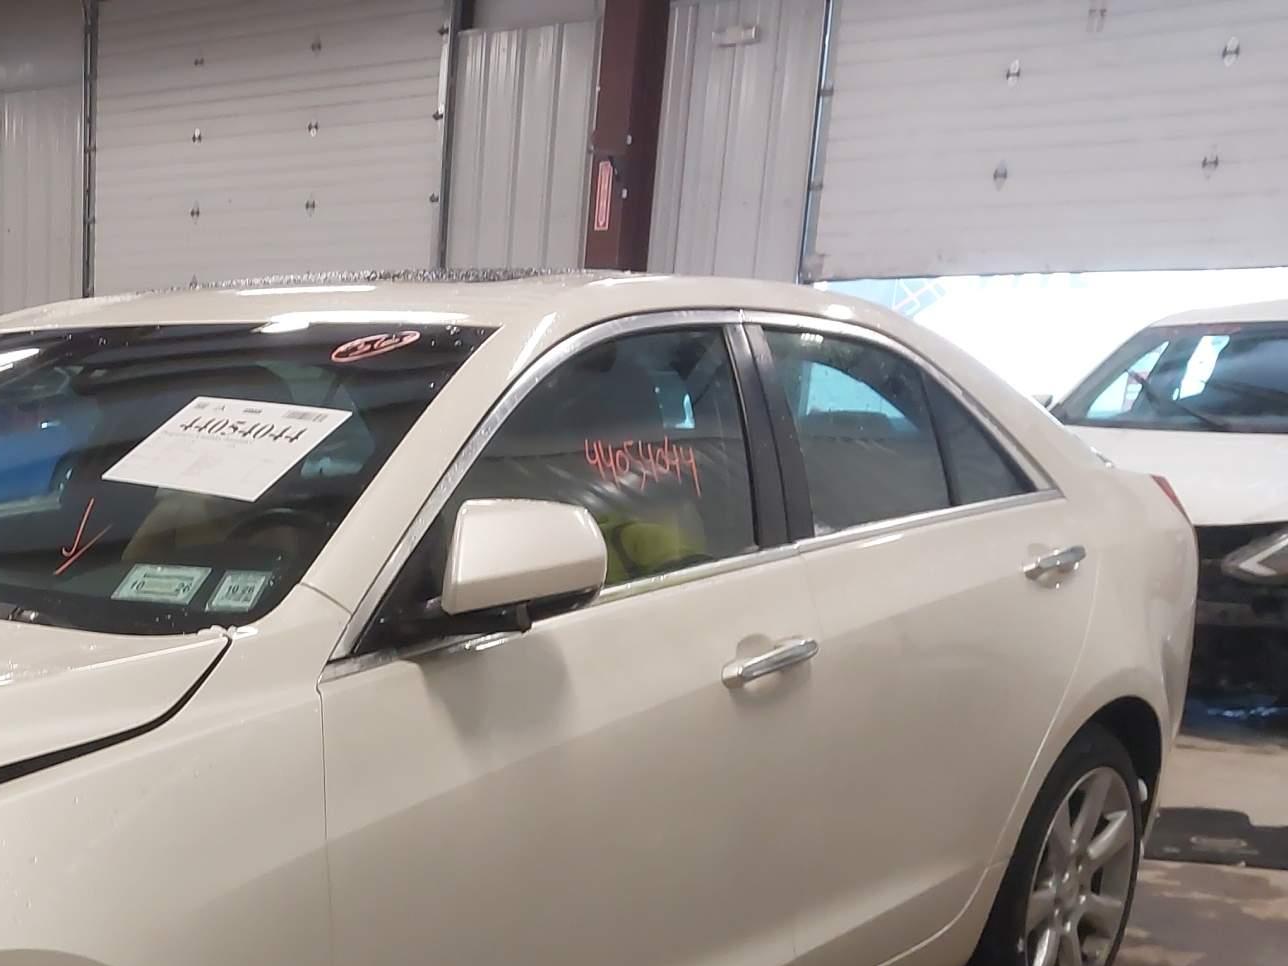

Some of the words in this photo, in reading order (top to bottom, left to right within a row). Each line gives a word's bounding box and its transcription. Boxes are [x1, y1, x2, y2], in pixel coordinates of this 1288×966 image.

[179, 415, 308, 443] 44054044
[584, 434, 702, 497] 44054044
[130, 580, 146, 591] 10
